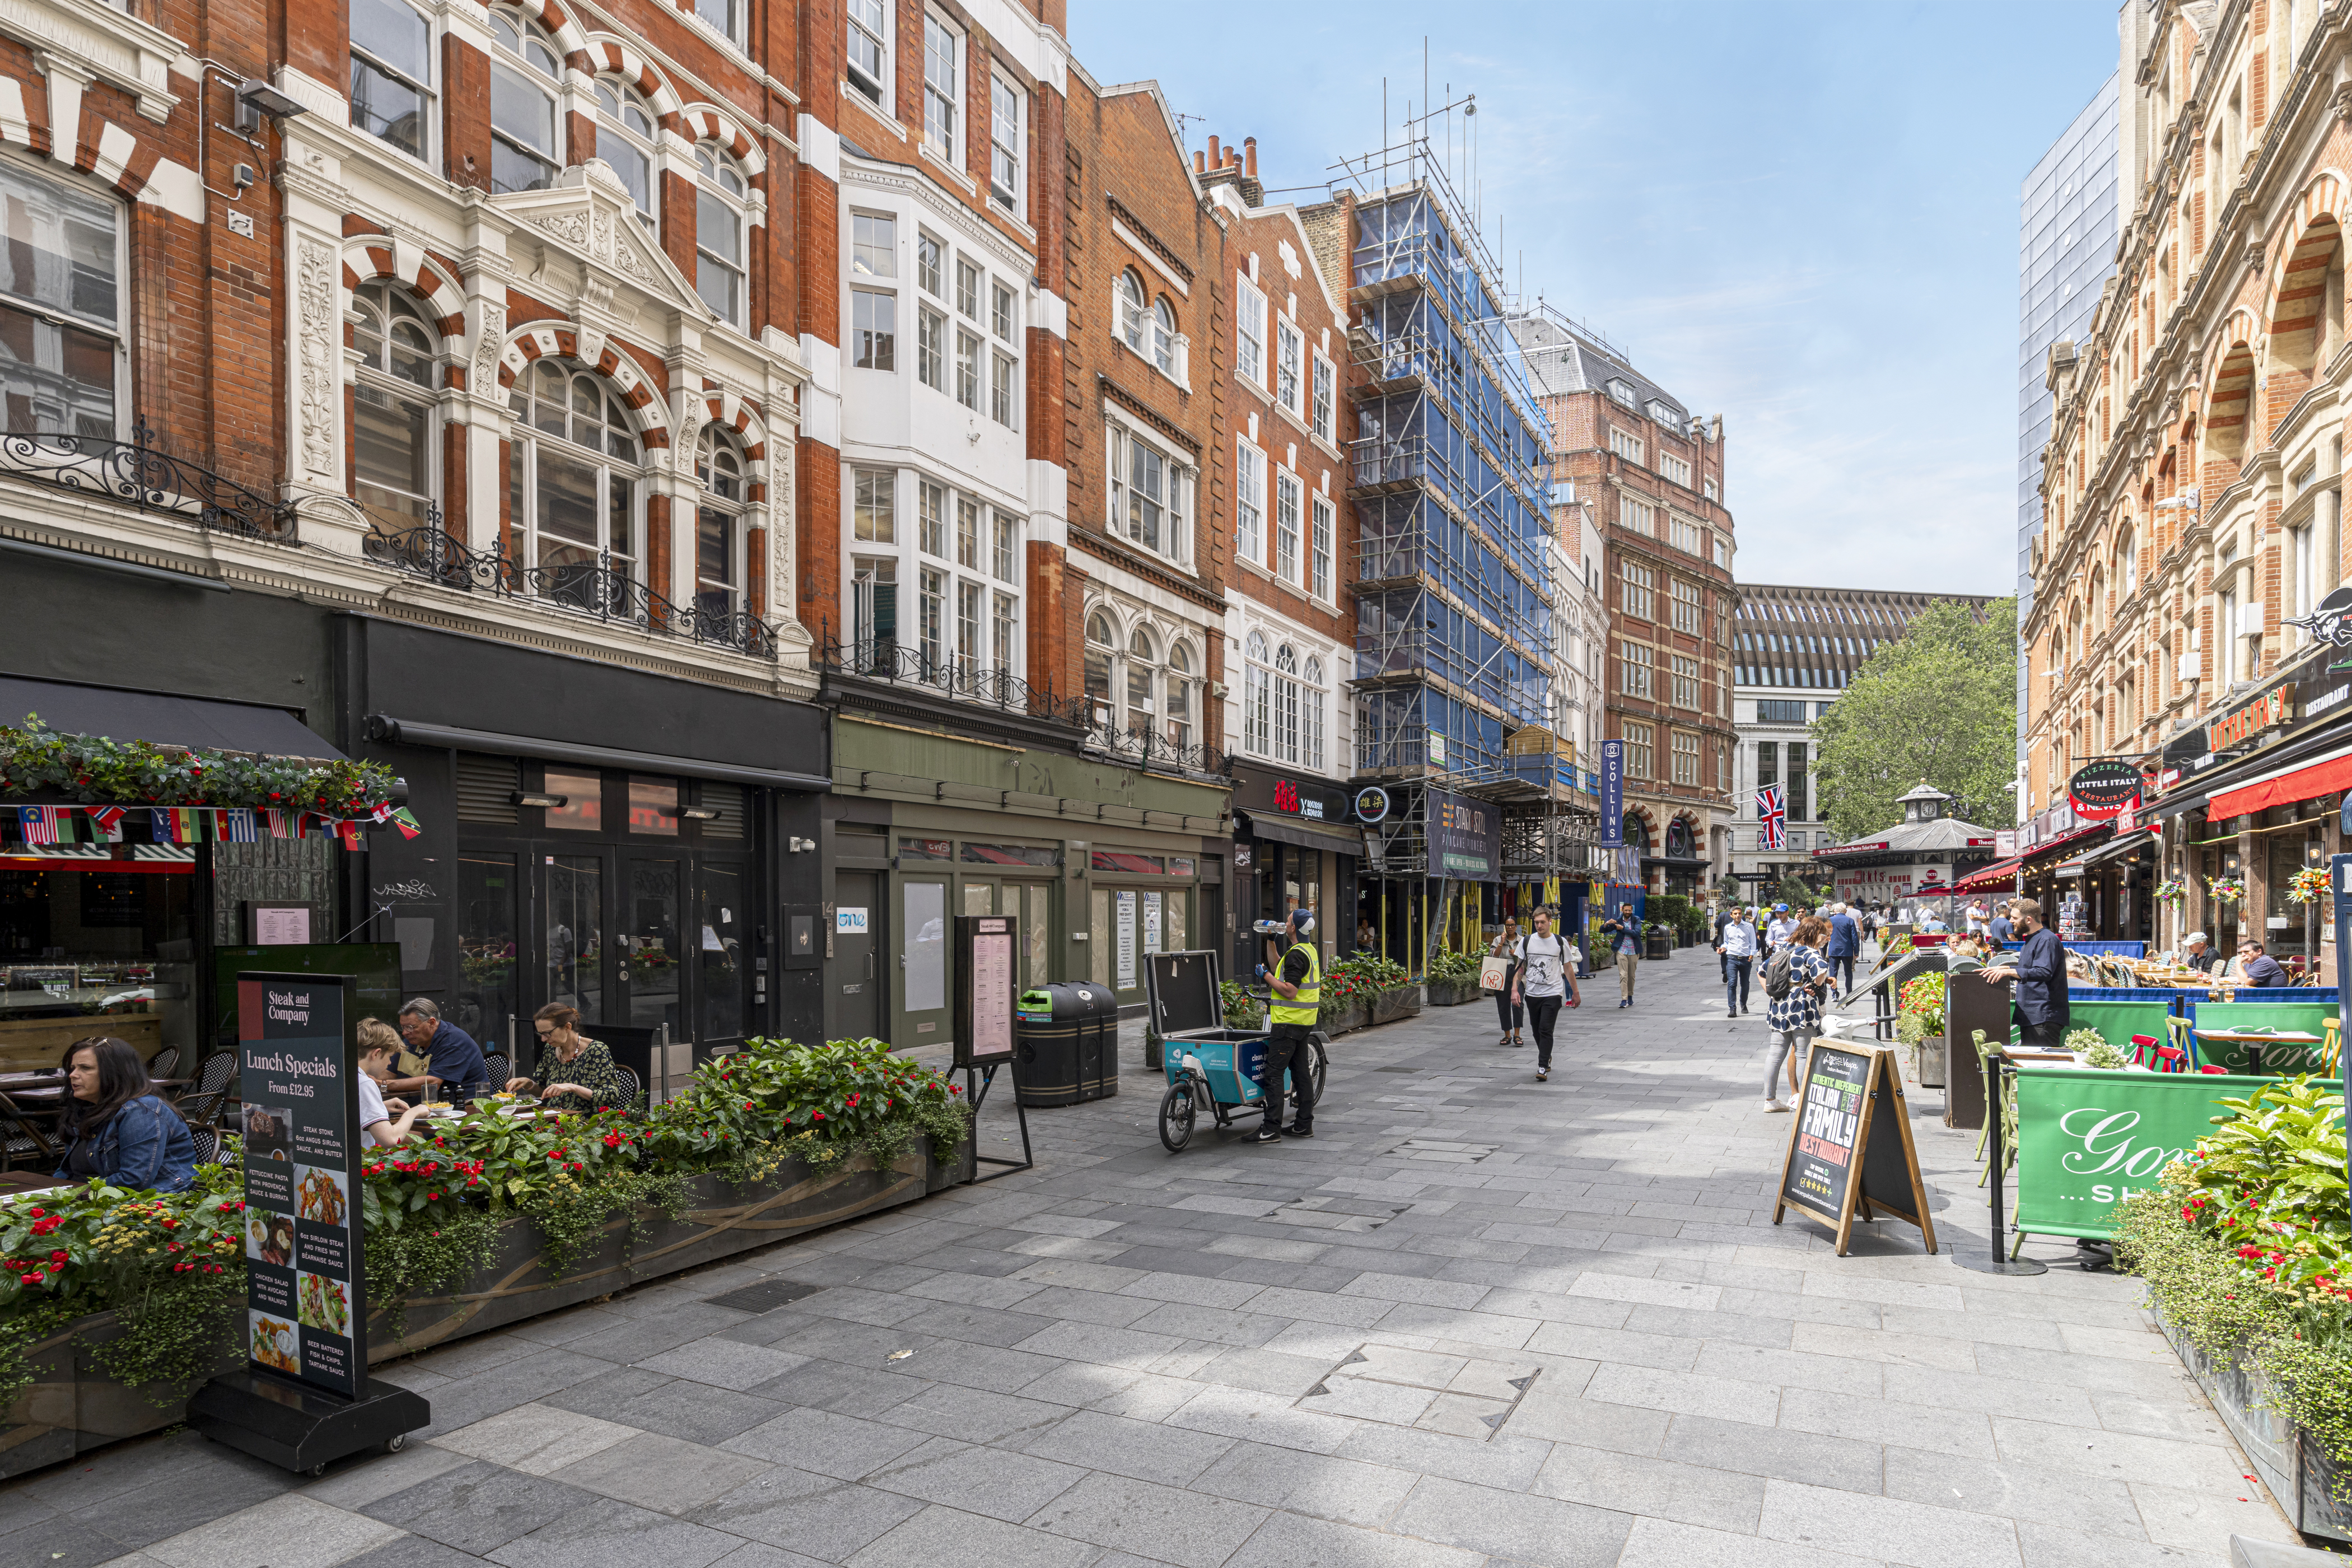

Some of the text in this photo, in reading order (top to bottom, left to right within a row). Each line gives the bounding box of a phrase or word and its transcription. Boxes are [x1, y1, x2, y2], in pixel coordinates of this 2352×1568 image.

[2306, 684, 2350, 718] RESTAURANT
[2211, 684, 2288, 753] LITTLE ITALY
[2080, 764, 2132, 779] PIZZERIA
[2076, 778, 2138, 788] LITTLE ITALY
[2080, 786, 2135, 802] RESTAURANT
[1457, 806, 1472, 832] STACK
[1863, 870, 1884, 883] tkts
[822, 902, 834, 916] 14
[838, 913, 866, 926] one
[269, 991, 309, 1007] Steak and
[269, 1005, 310, 1026] Company
[246, 1050, 336, 1079] Lunch Specials
[1843, 1057, 1858, 1071] Vespa
[269, 1081, 314, 1098] From £12.95
[1812, 1074, 1863, 1095] AUTHENTIC INDEPENDENT
[1808, 1084, 1840, 1109] ITALIAN
[1803, 1102, 1857, 1148] FAMILY
[296, 1145, 312, 1154] SAUCE,
[325, 1150, 343, 1158] BUTTER
[322, 1139, 342, 1149] SIRLOIN,
[1799, 1132, 1851, 1168] RESTAURANT
[249, 1169, 273, 1179] FETTUCCINE
[262, 1181, 287, 1192] PROVENÇAL
[269, 1192, 289, 1202] BURRATA
[1792, 1187, 1838, 1212] www.vespaitalianrestaurant.com
[310, 1234, 328, 1244] SIRLOIN
[329, 1239, 344, 1248] STEAK
[315, 1246, 328, 1254] FRIES
[329, 1249, 340, 1257] WITH
[302, 1252, 343, 1268] BÉARNAISE SAUCE
[255, 1273, 288, 1287] CHICKEN SALAD
[256, 1282, 287, 1296] WITH AVOCADO
[268, 1295, 287, 1306] WALNUTS
[307, 1340, 344, 1356] BEER BATTERED
[310, 1350, 320, 1359] FISH
[326, 1356, 342, 1366] CHIPS,
[308, 1359, 345, 1376] TARTARE SAUCE
